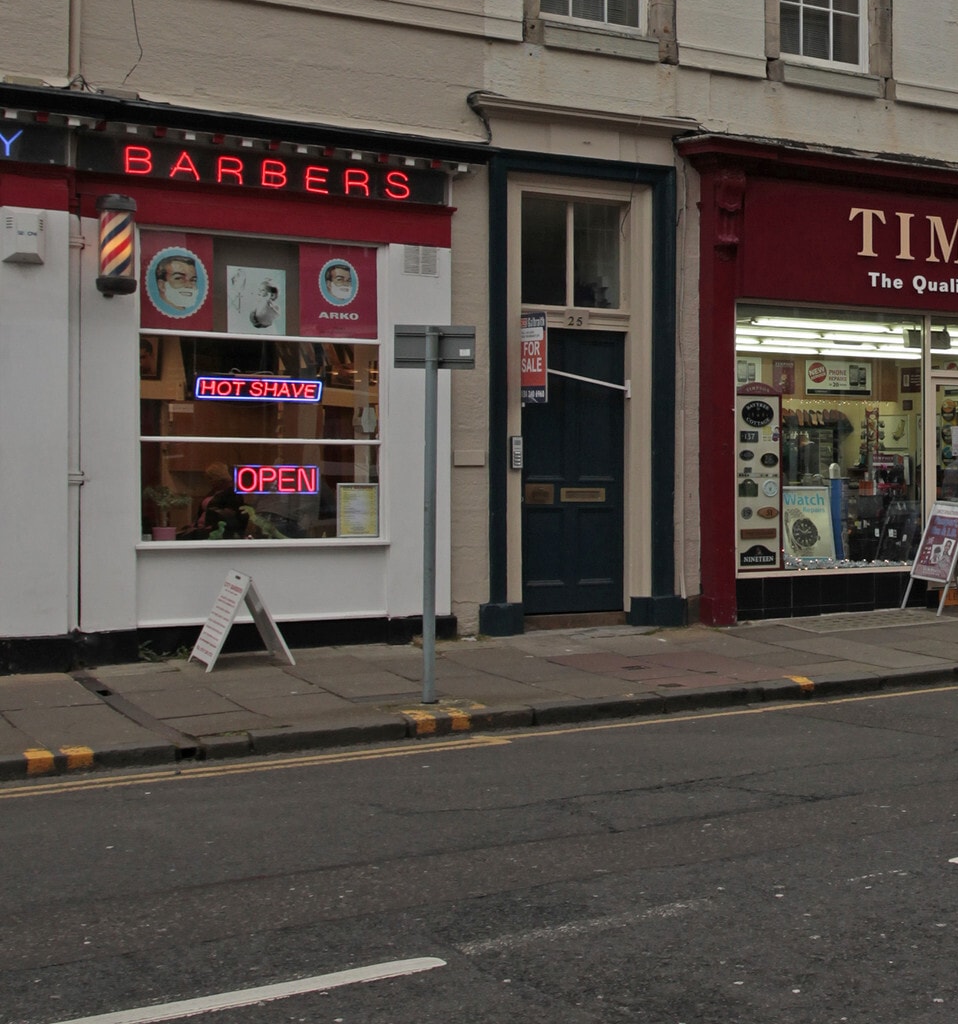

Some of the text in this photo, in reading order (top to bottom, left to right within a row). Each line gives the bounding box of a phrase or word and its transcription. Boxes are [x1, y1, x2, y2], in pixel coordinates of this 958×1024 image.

[124, 144, 411, 200] BARBERS
[868, 272, 903, 290] The
[318, 312, 359, 321] ARKO
[567, 316, 583, 326] 25
[523, 341, 540, 356] FOR
[521, 357, 542, 372] SALE
[808, 366, 825, 377] NEW
[200, 380, 318, 399] HOT SHAVE
[237, 466, 316, 492] OPEN
[784, 493, 825, 506] Watch
